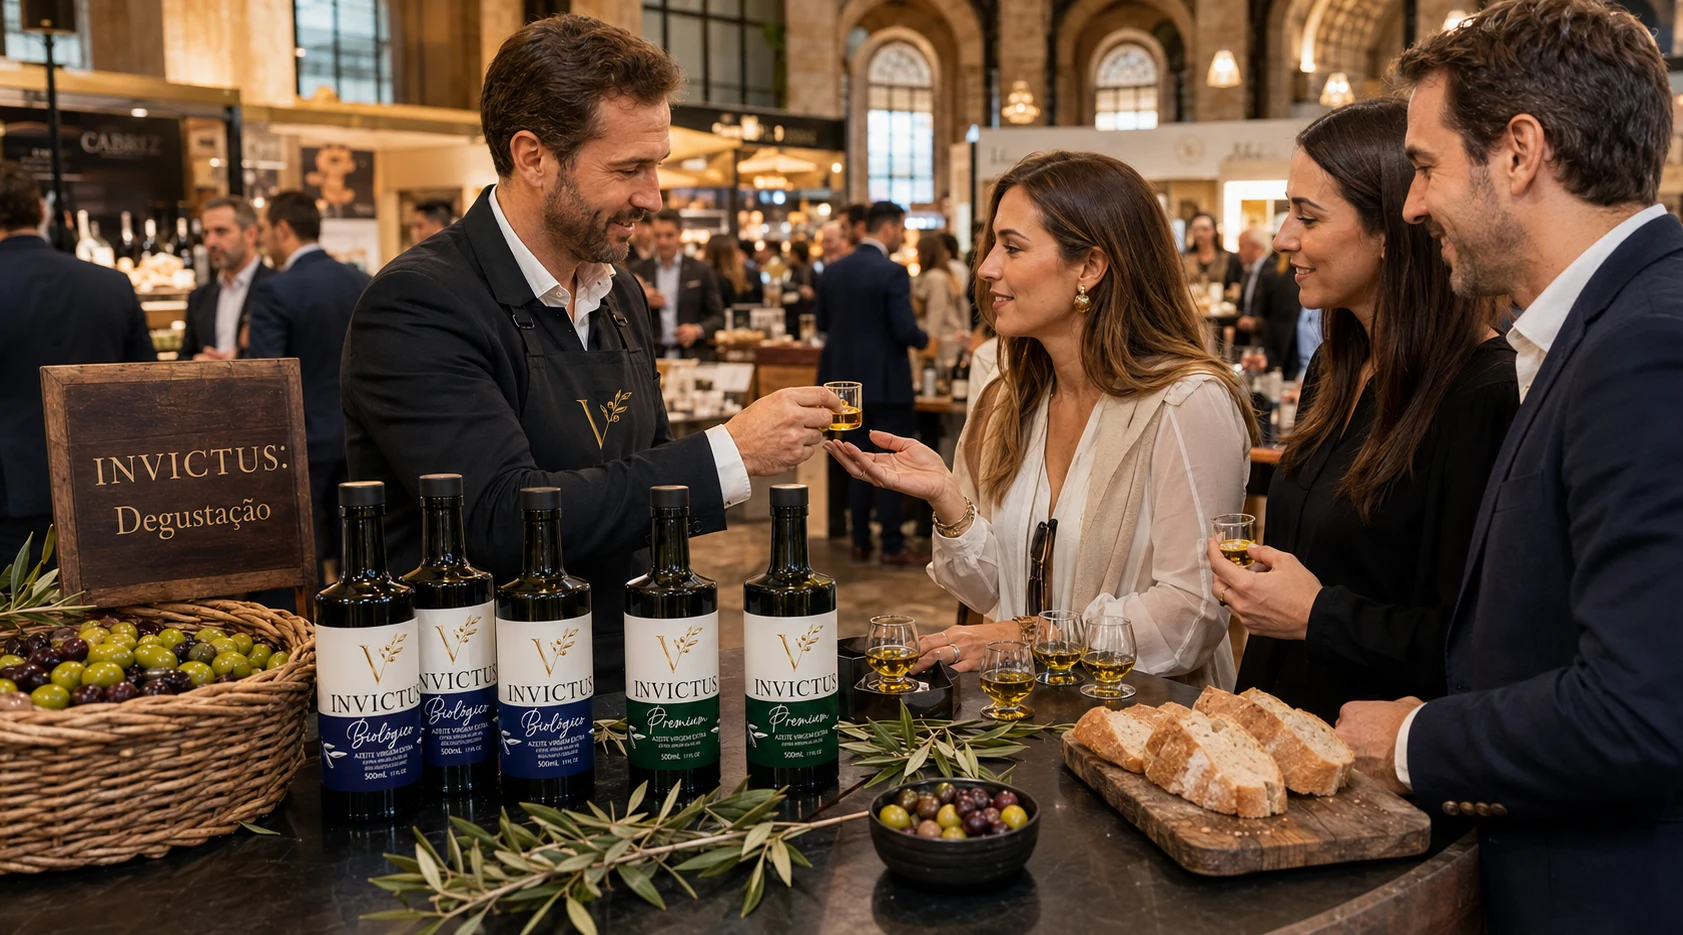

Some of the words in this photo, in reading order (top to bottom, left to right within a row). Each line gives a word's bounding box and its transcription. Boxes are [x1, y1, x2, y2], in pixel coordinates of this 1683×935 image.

[93, 444, 288, 486] INVICTUS:
[113, 497, 272, 540] Degustação
[419, 663, 496, 690] NVICTUS
[508, 675, 592, 703] INVICTUS
[634, 675, 717, 699] INVICTUS
[754, 673, 837, 698] INVICTUS
[424, 694, 489, 726] Biológico
[520, 707, 586, 739] Biológico
[646, 705, 708, 735] Premium
[768, 703, 830, 733] Premium
[346, 717, 414, 750] Biológico
